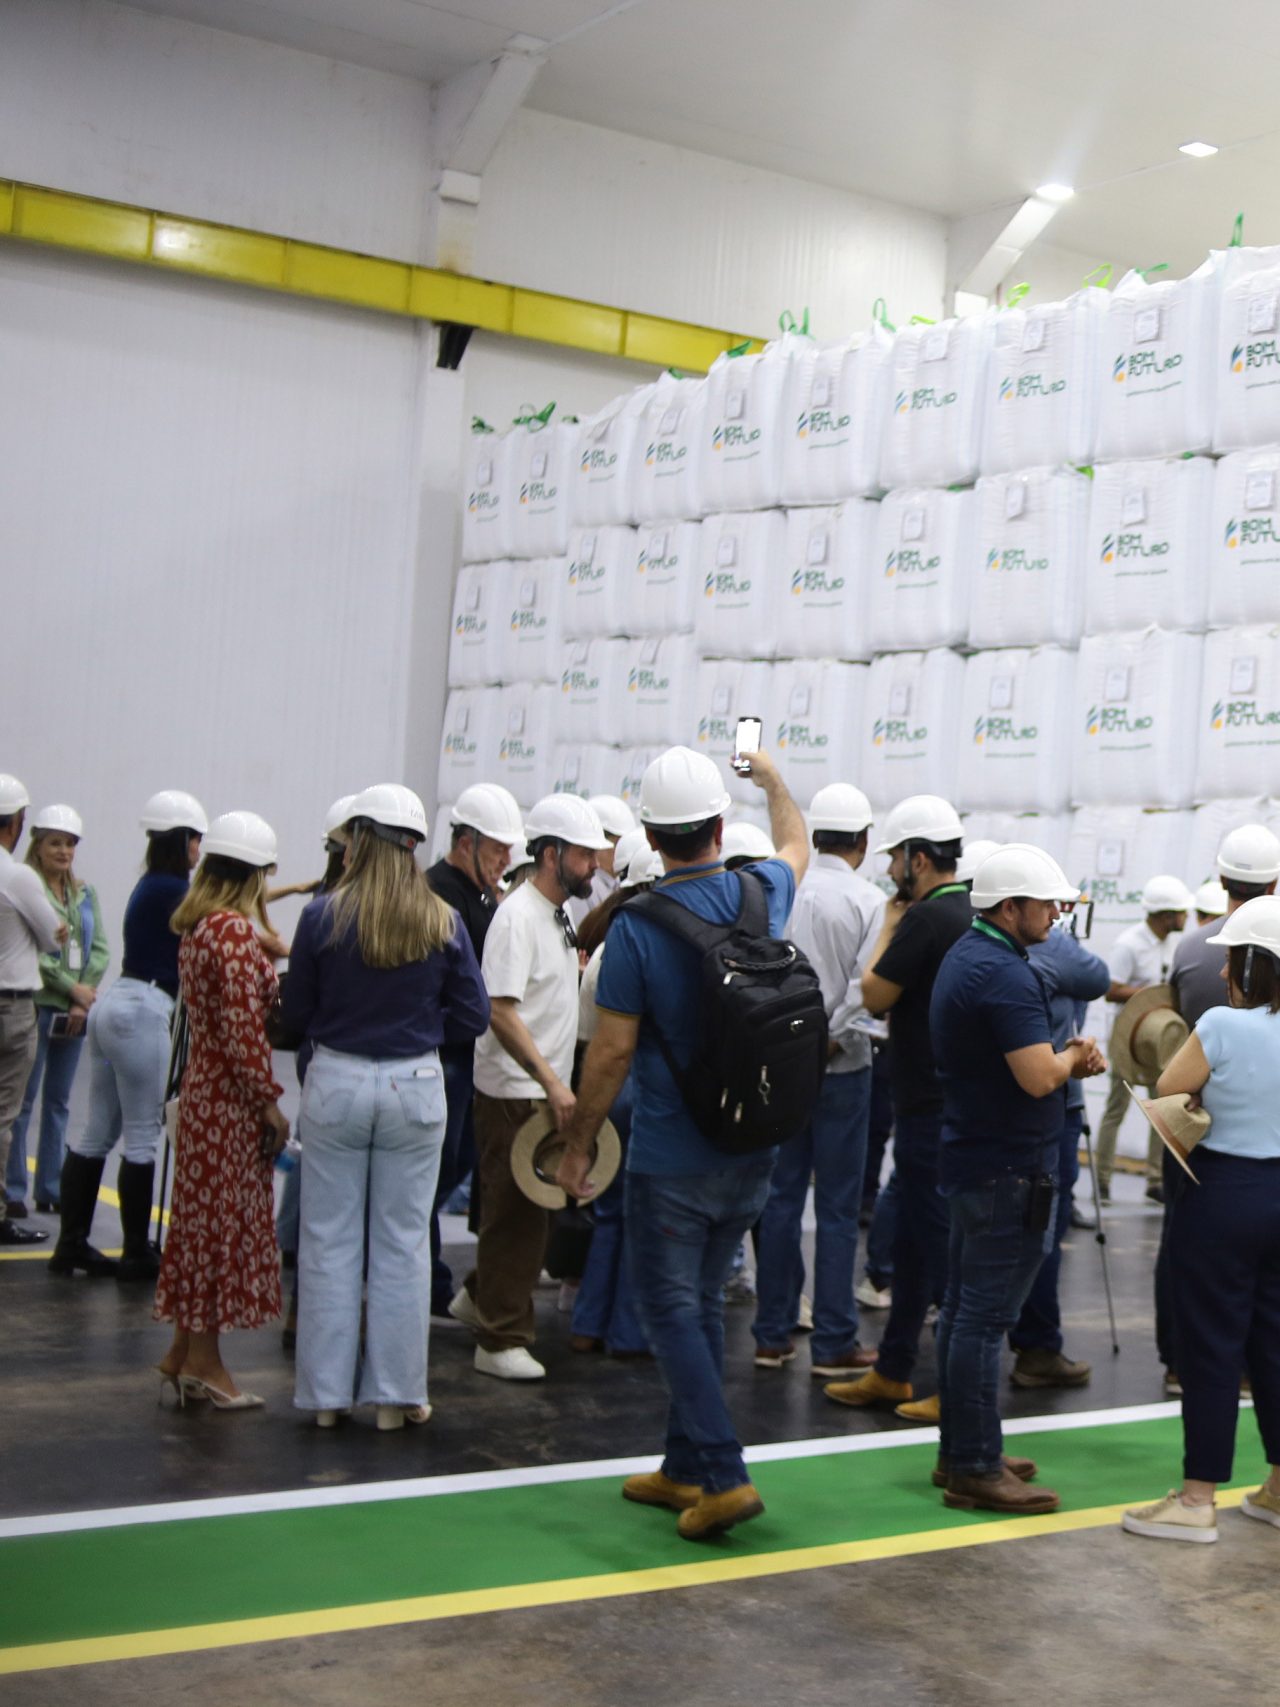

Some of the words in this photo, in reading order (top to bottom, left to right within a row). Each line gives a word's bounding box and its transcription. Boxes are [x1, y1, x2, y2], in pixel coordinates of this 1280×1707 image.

[1247, 340, 1275, 356] BOM
[1129, 351, 1155, 367] BOM
[1129, 354, 1183, 378] FUTURO
[1018, 374, 1042, 387] BOM
[1017, 380, 1067, 397] FUTURO
[1240, 518, 1271, 531] BOM
[1118, 534, 1142, 546] BOM
[1116, 542, 1170, 558] FUTURO
[1101, 707, 1127, 719] BOM
[1227, 701, 1256, 714] BOM
[1101, 717, 1153, 732] FUTURO
